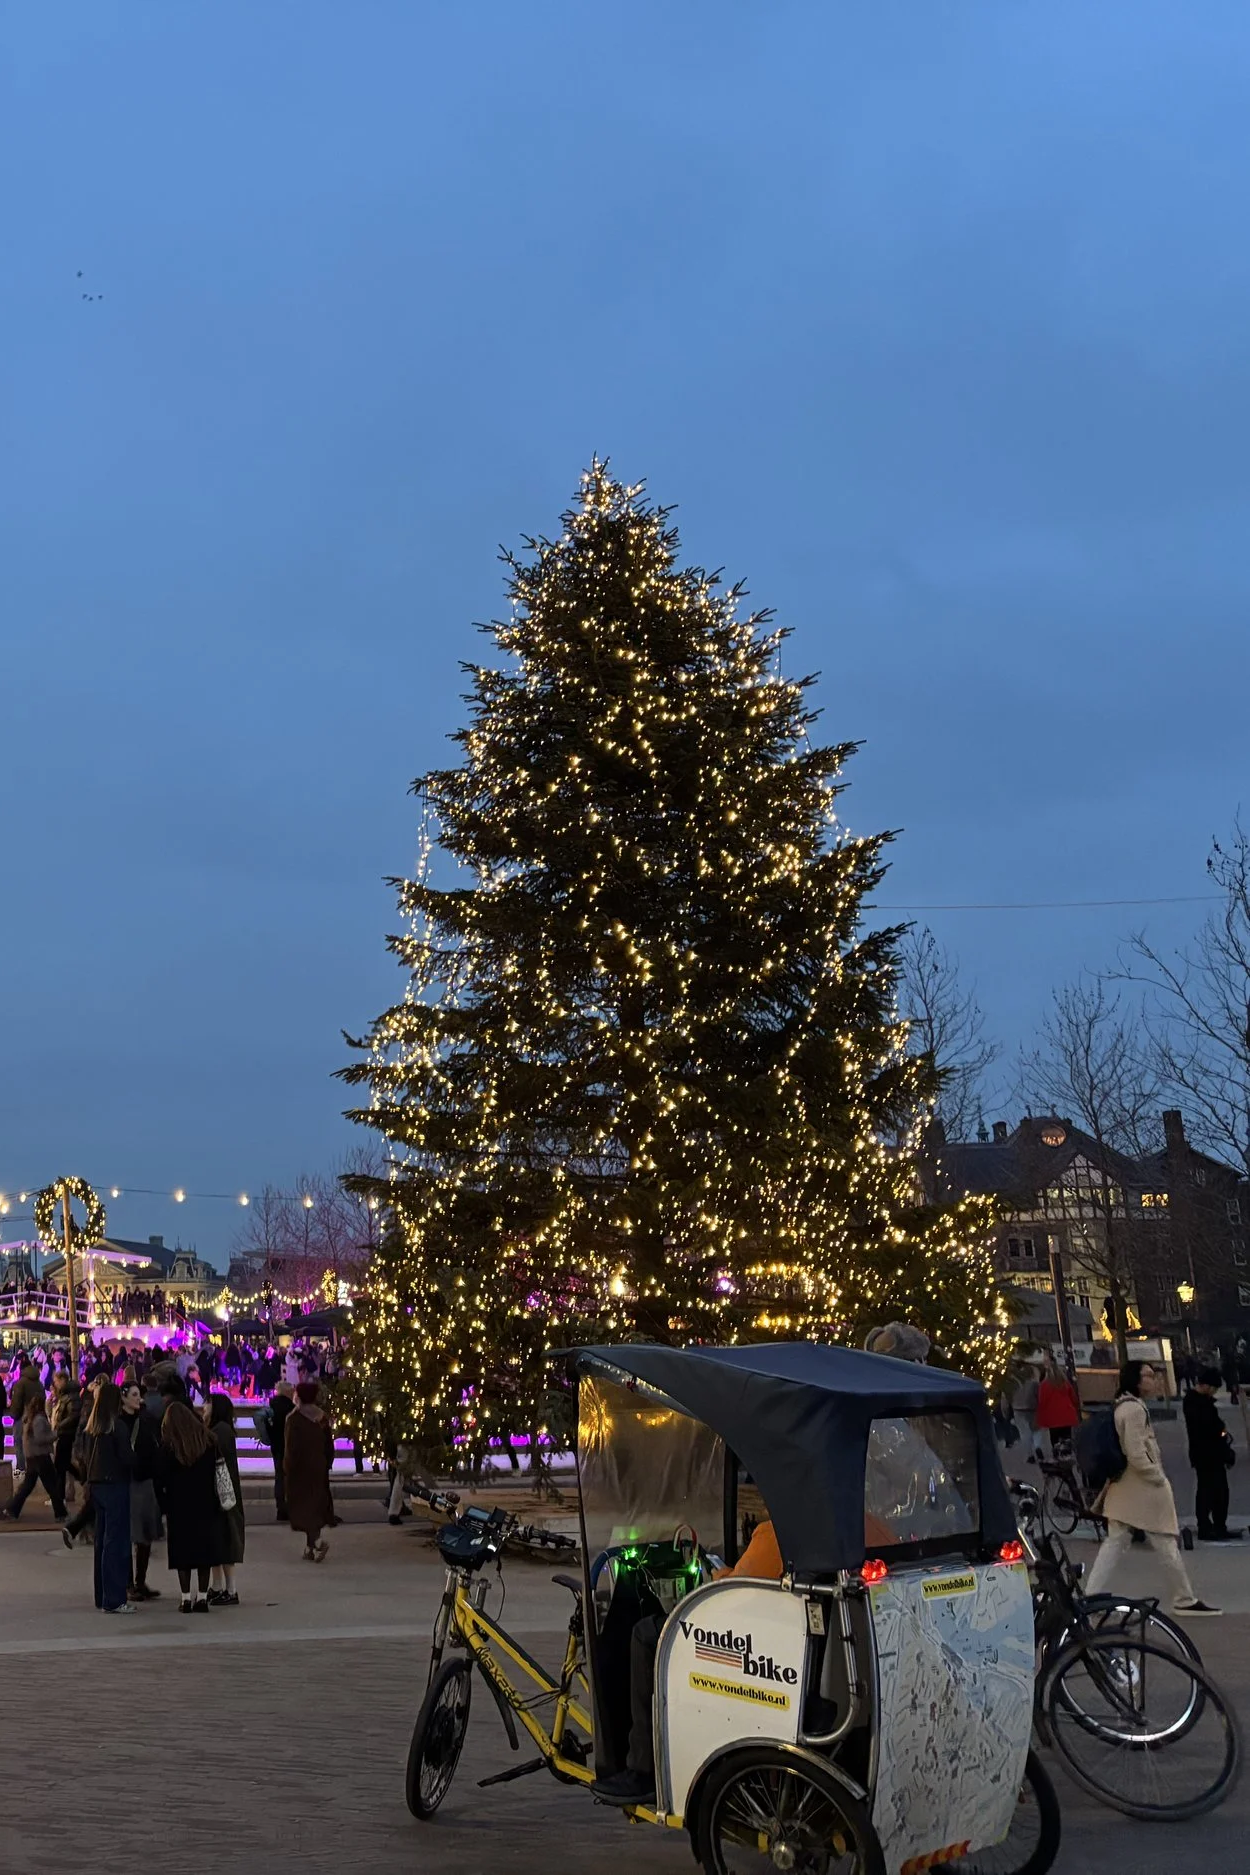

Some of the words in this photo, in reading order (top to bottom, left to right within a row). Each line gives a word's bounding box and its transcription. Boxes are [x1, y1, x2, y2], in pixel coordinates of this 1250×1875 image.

[679, 1620, 752, 1654] Vondel
[742, 1653, 798, 1685] bike
[692, 1676, 786, 1706] www.vondelbike.nl
